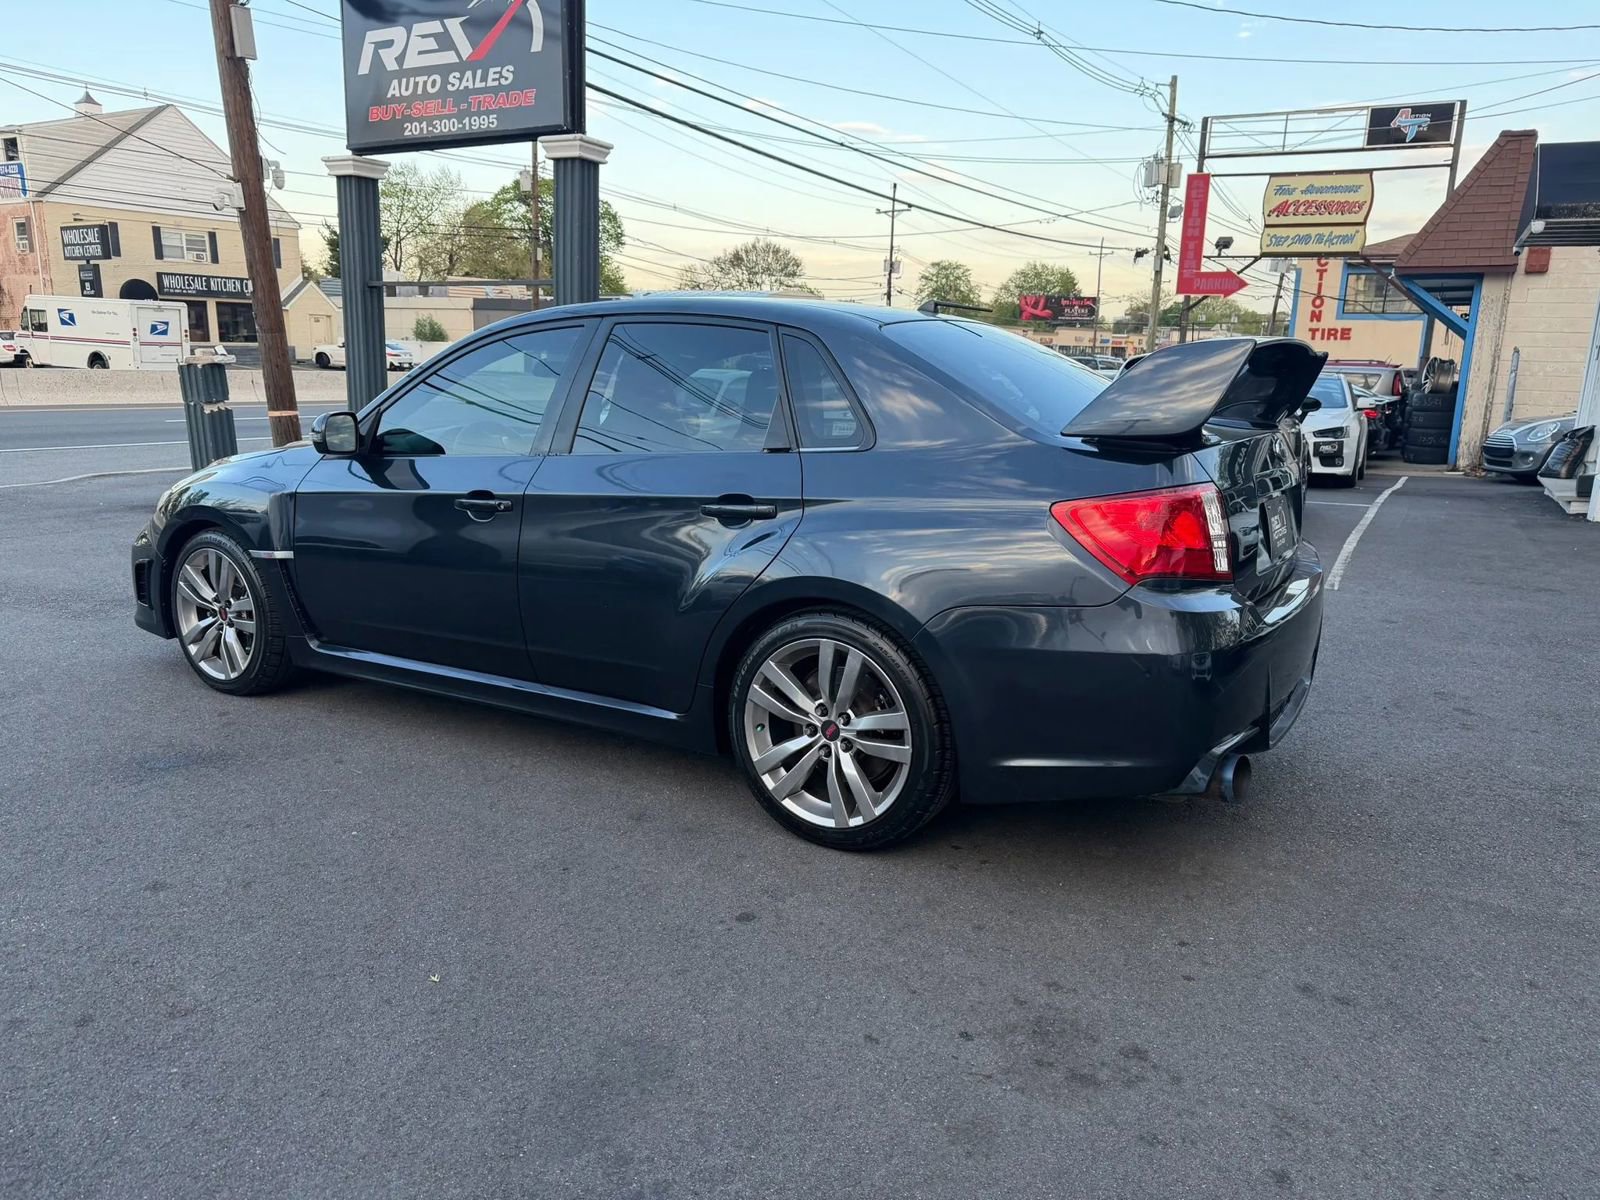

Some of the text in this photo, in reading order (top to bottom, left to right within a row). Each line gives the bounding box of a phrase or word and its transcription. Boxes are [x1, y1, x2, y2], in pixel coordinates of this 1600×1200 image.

[386, 65, 514, 99] AUTO SALES
[469, 89, 536, 111] TRADE
[403, 115, 498, 136] 201-300-1995
[1267, 199, 1367, 217] ACCESSORIES
[62, 227, 100, 244] WHOLESALE
[64, 244, 102, 257] KITCHEN CENTER
[162, 274, 208, 291] WHOLESALE
[209, 277, 242, 293] KITCHEN
[1310, 256, 1329, 322] CTION
[1308, 327, 1352, 341] TIRE
